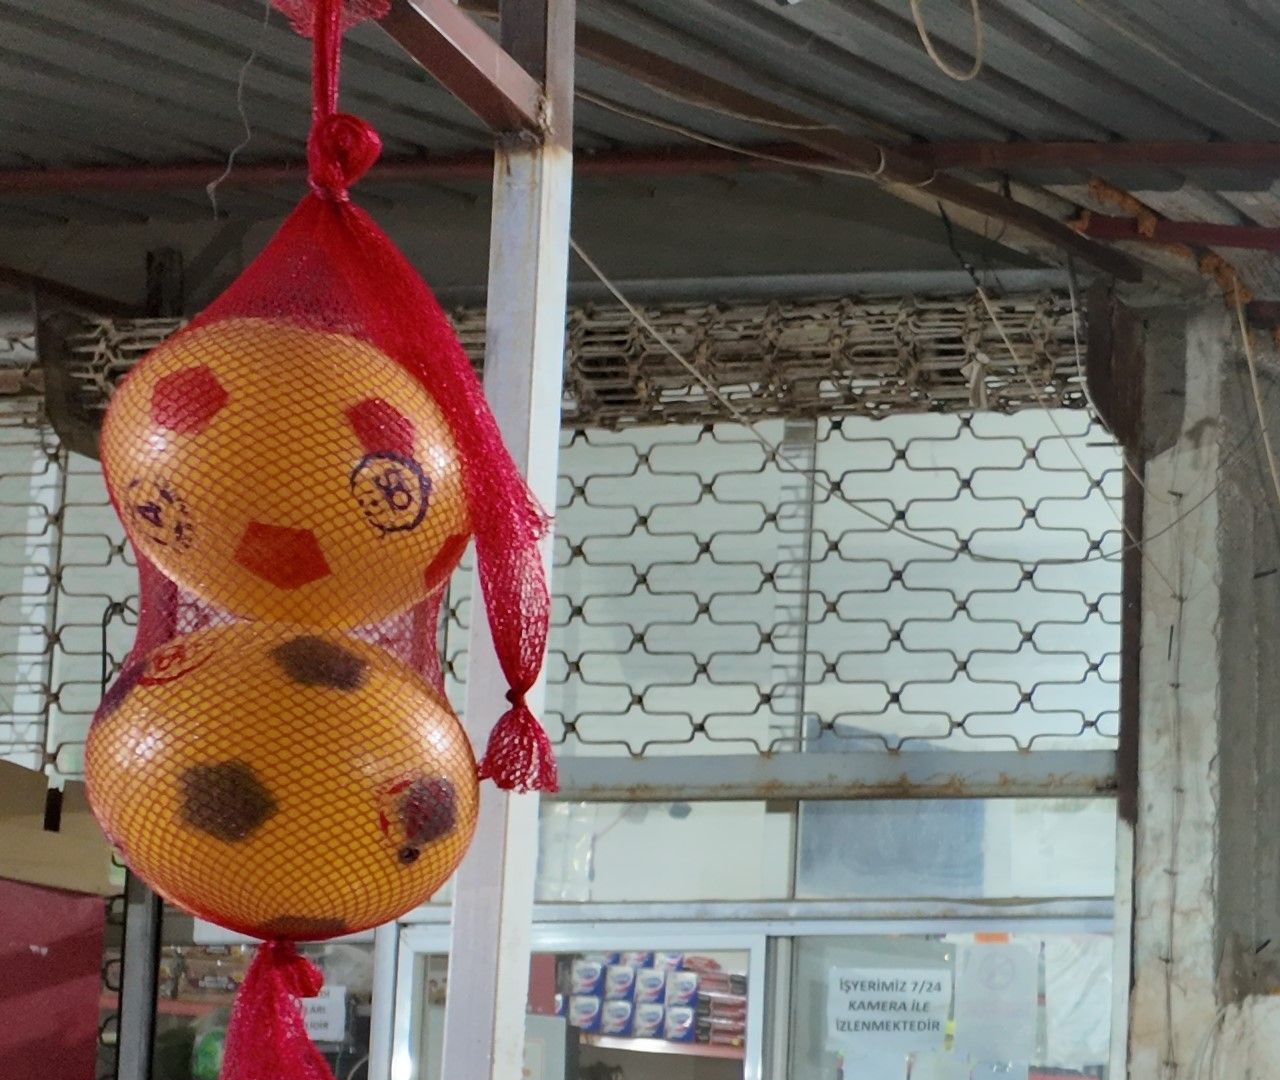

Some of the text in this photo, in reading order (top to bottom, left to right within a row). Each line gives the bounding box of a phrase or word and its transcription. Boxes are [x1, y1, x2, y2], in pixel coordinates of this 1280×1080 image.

[839, 977, 942, 994] İŞYERİMİZ 7/24
[848, 999, 931, 1013] KAMERA İLE
[835, 1018, 940, 1032] İZLENMEKTEDİR
